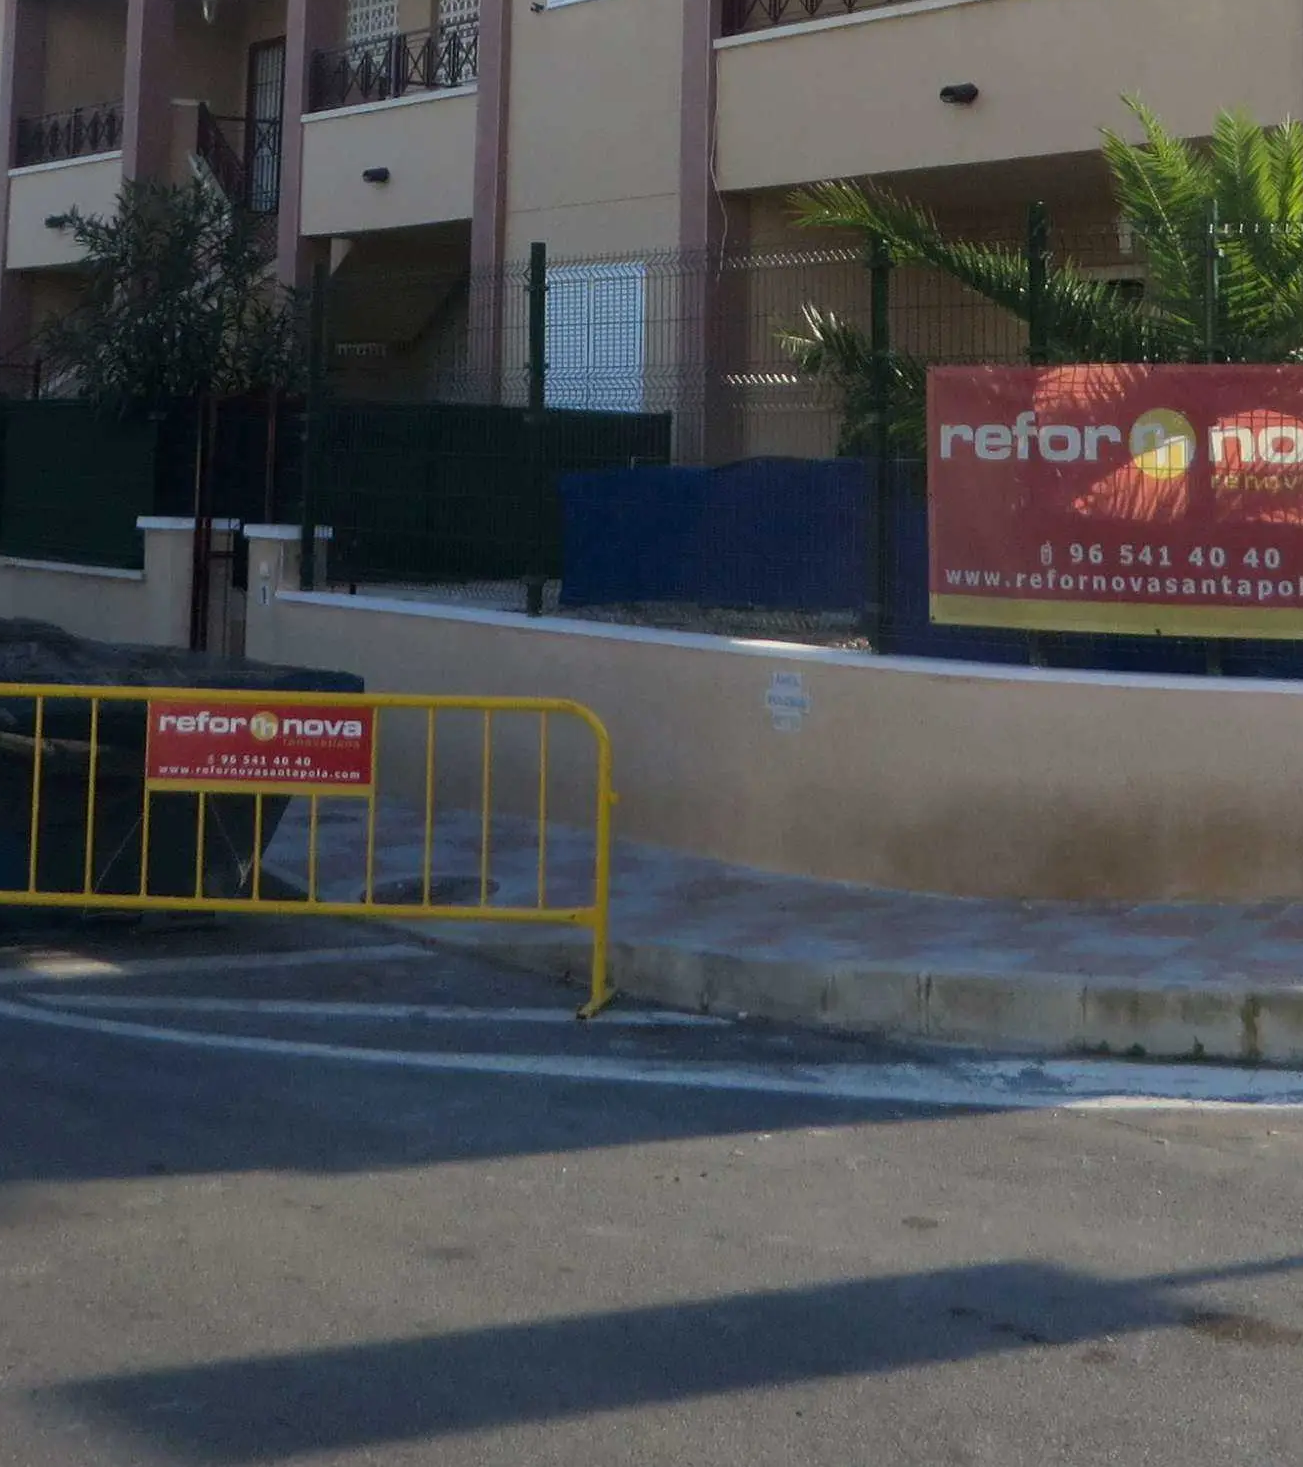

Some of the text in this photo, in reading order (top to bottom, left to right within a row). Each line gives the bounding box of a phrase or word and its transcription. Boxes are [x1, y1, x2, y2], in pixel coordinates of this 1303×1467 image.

[940, 411, 1121, 462] refor
[1069, 542, 1281, 569] 96 541 40 40
[159, 711, 362, 739] refor nova
[221, 754, 311, 767] 96 541 40 40
